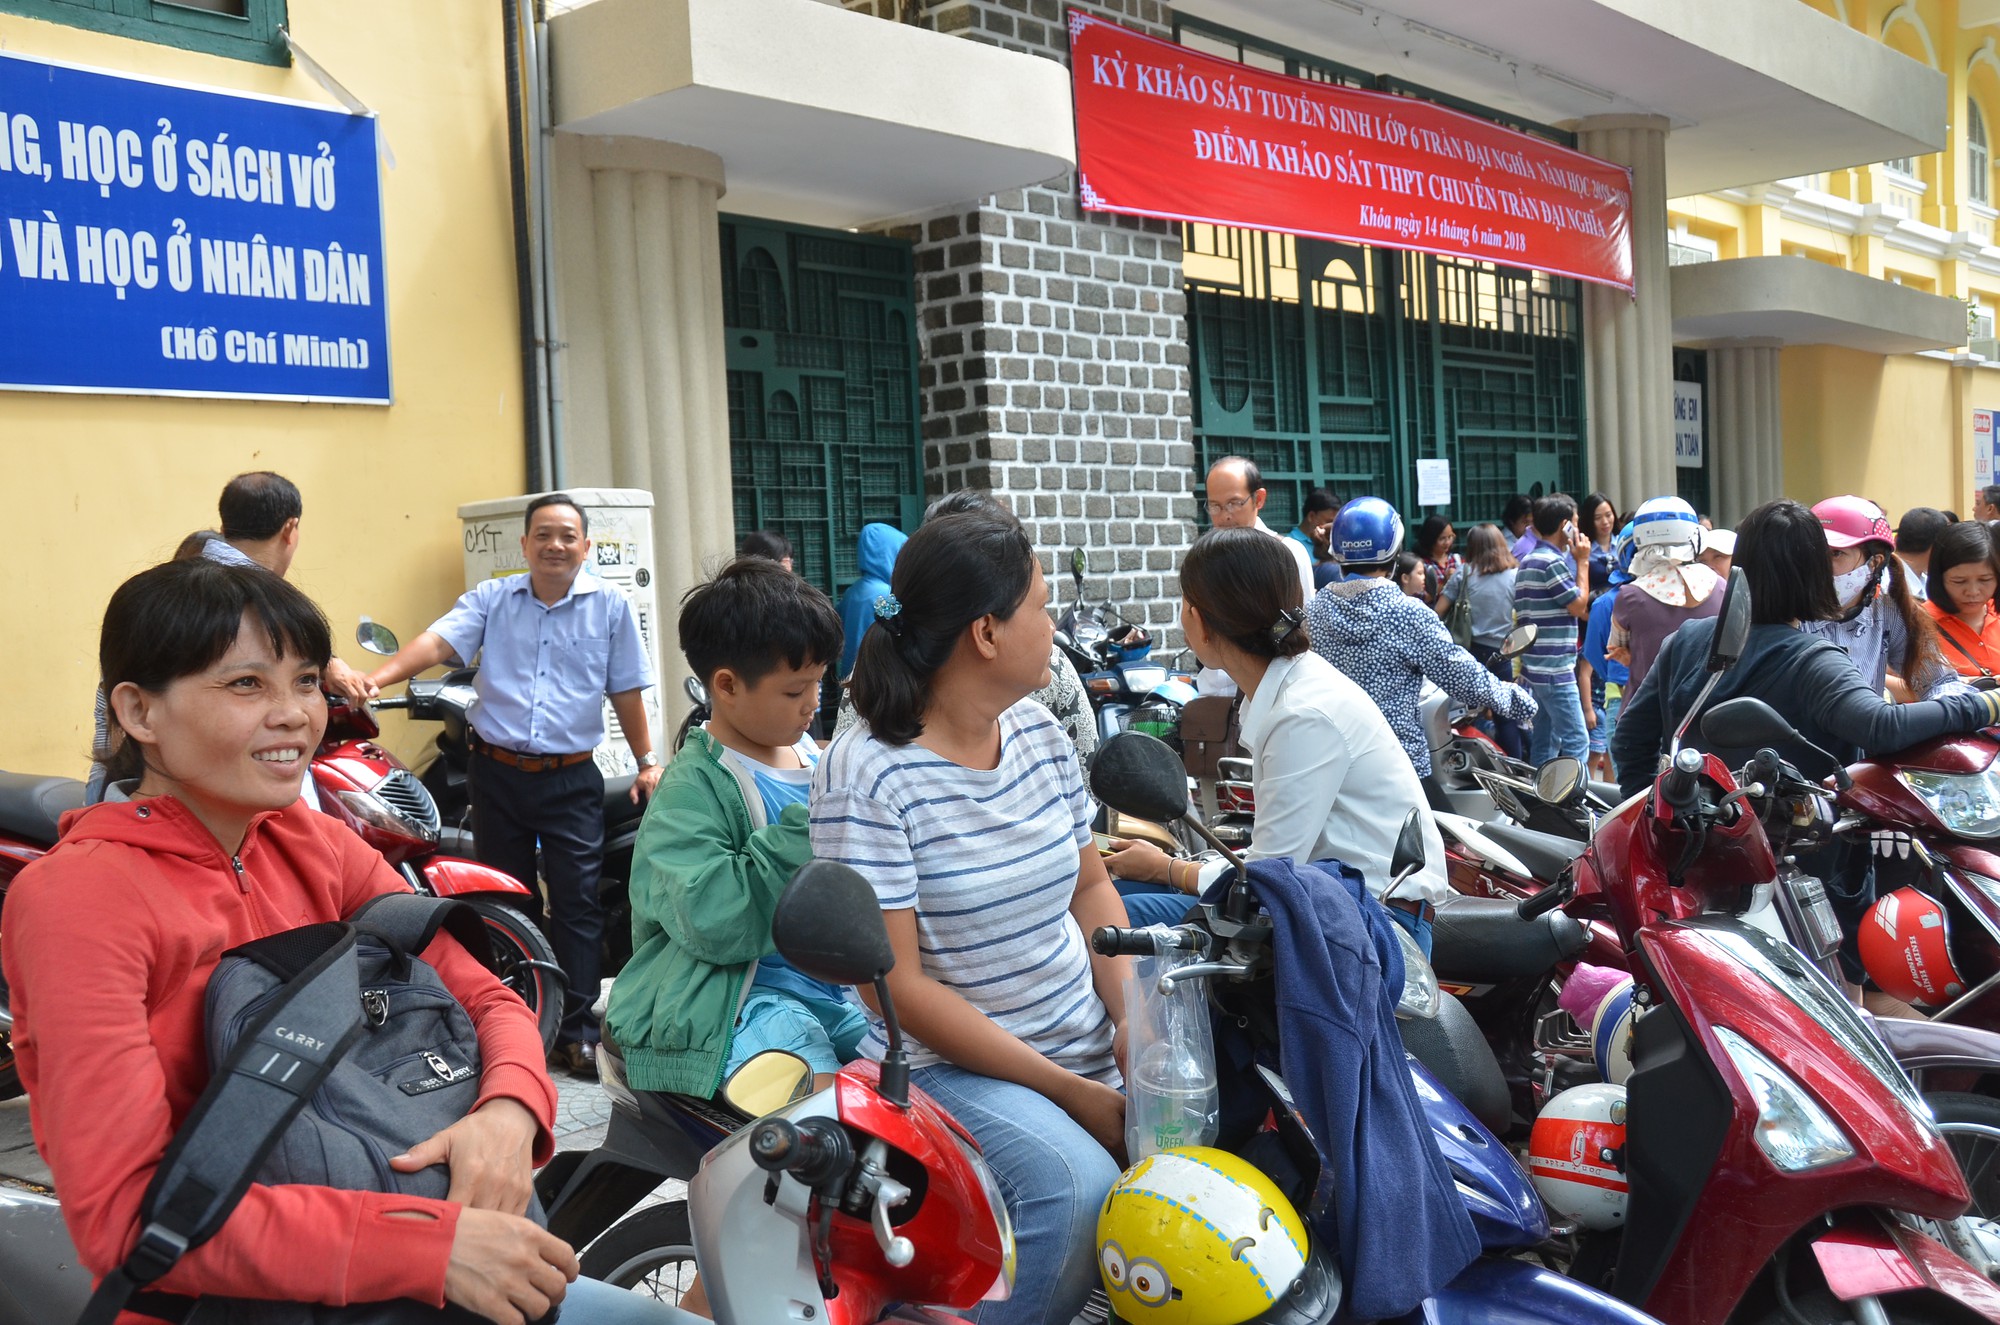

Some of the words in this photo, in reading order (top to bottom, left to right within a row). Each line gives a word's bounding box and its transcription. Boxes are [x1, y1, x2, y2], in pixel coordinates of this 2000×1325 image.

[1091, 50, 1129, 89] KỲ
[1136, 63, 1208, 104] KHẢO
[1212, 75, 1253, 113] SÁT
[1257, 89, 1326, 128] TUYỂN
[1329, 105, 1373, 139] SINH
[1374, 112, 1408, 146] LỚP
[1410, 125, 1420, 150] 6
[1419, 127, 1464, 160] TRẦN
[1465, 140, 1491, 172] ĐẠI
[1491, 149, 1537, 180] NGHĨA
[1537, 161, 1567, 189] NĂM
[1568, 172, 1591, 200] HỌC
[58, 120, 144, 199] HỌC
[152, 117, 178, 193] Ở
[185, 132, 284, 206] SÁCH
[288, 141, 336, 212] VỞ
[1191, 125, 1261, 169] ĐIỂM
[1263, 140, 1332, 181] KHẢO
[1334, 149, 1373, 187] SÁT
[1375, 162, 1424, 198] THPT
[1427, 173, 1499, 213] CHUYÊN
[1498, 186, 1542, 222] TRẦN
[1542, 203, 1567, 232] ĐẠI
[1567, 208, 1607, 239] NGHĨA
[1359, 204, 1392, 230] Khóa
[1394, 212, 1422, 239] ngày
[1425, 215, 1437, 236] 14
[1440, 220, 1470, 248] tháng
[1472, 224, 1479, 243] 6
[1481, 228, 1502, 249] năm
[1504, 229, 1527, 252] 2018
[9, 209, 70, 282] VÀ
[75, 224, 160, 300] HỌC
[166, 218, 193, 293] Ở
[200, 233, 298, 300] NHÂN
[303, 241, 371, 306] DÂN
[160, 325, 218, 362] (Hồ
[224, 330, 278, 364] Chí
[283, 334, 370, 370] Minh)
[1689, 397, 1698, 420] EM
[1676, 433, 1684, 456] AN
[1684, 426, 1699, 456] TOÀN
[275, 1026, 325, 1050] CARRY
